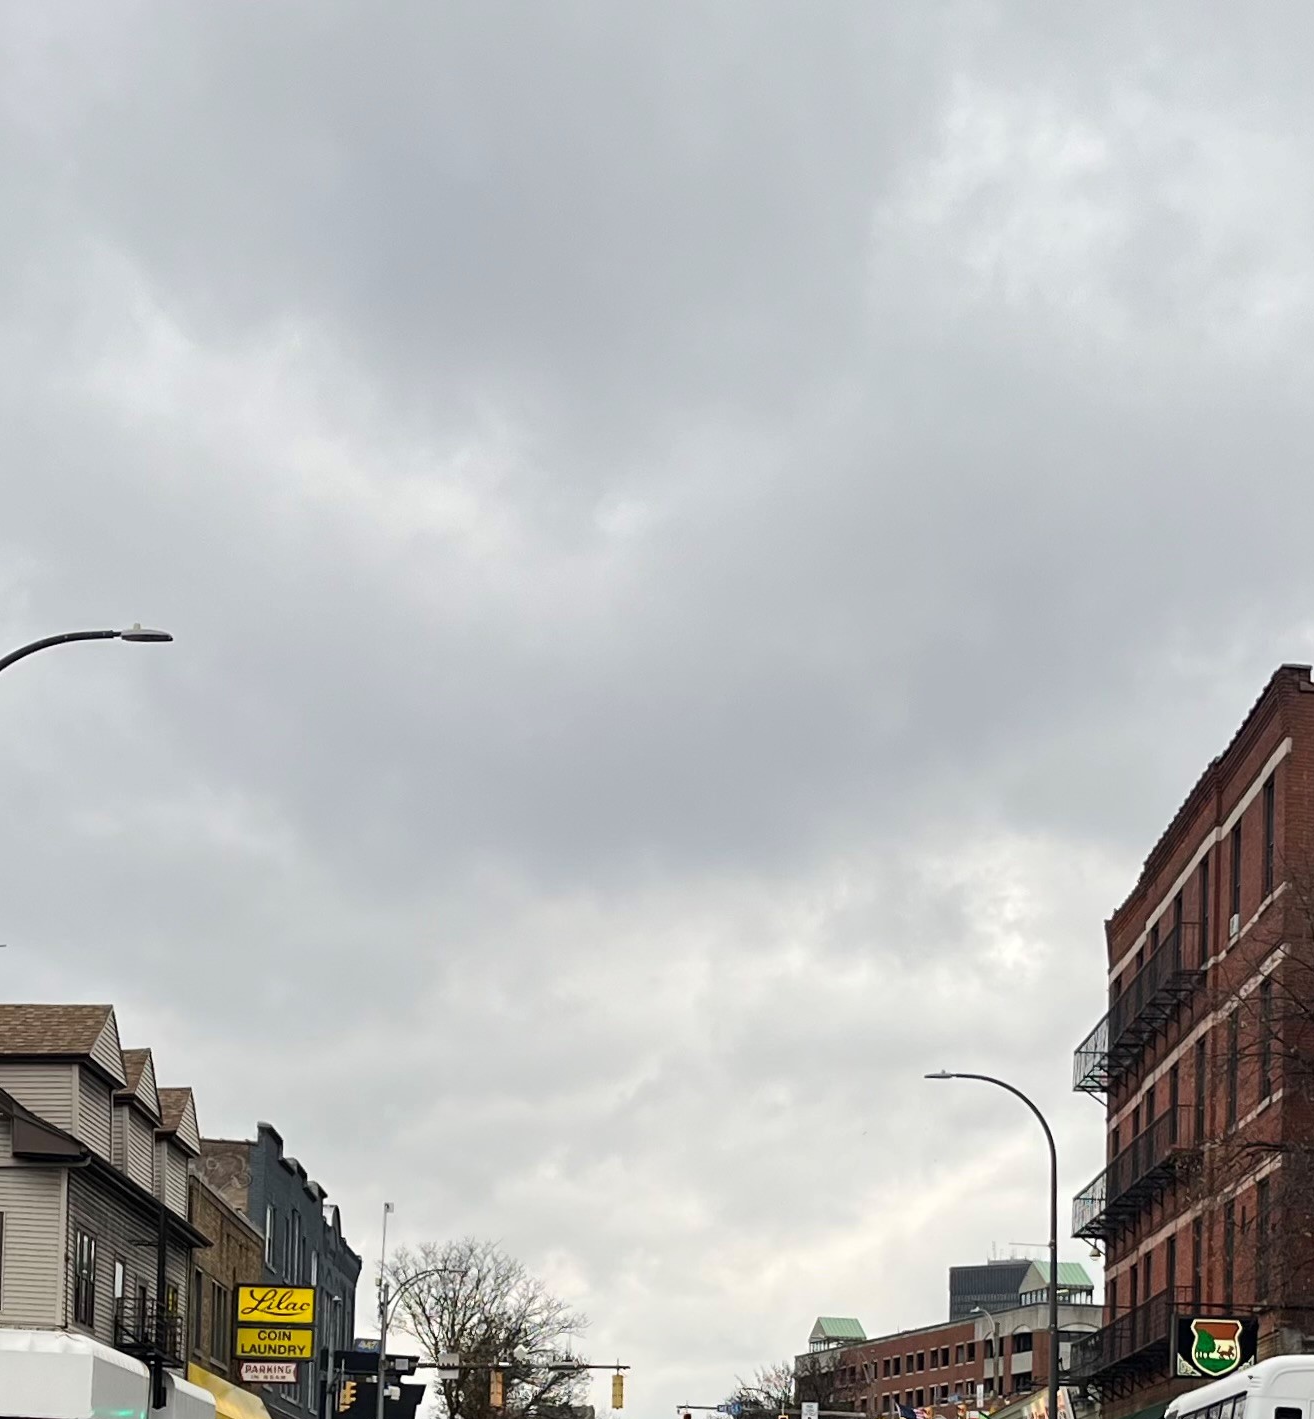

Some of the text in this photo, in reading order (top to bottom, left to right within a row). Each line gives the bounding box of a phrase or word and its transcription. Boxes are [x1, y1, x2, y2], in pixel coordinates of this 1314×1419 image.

[240, 1288, 311, 1317] Lilac
[257, 1330, 292, 1341] COIN
[240, 1344, 306, 1356] LAUNDRY
[244, 1364, 292, 1374] PARKING
